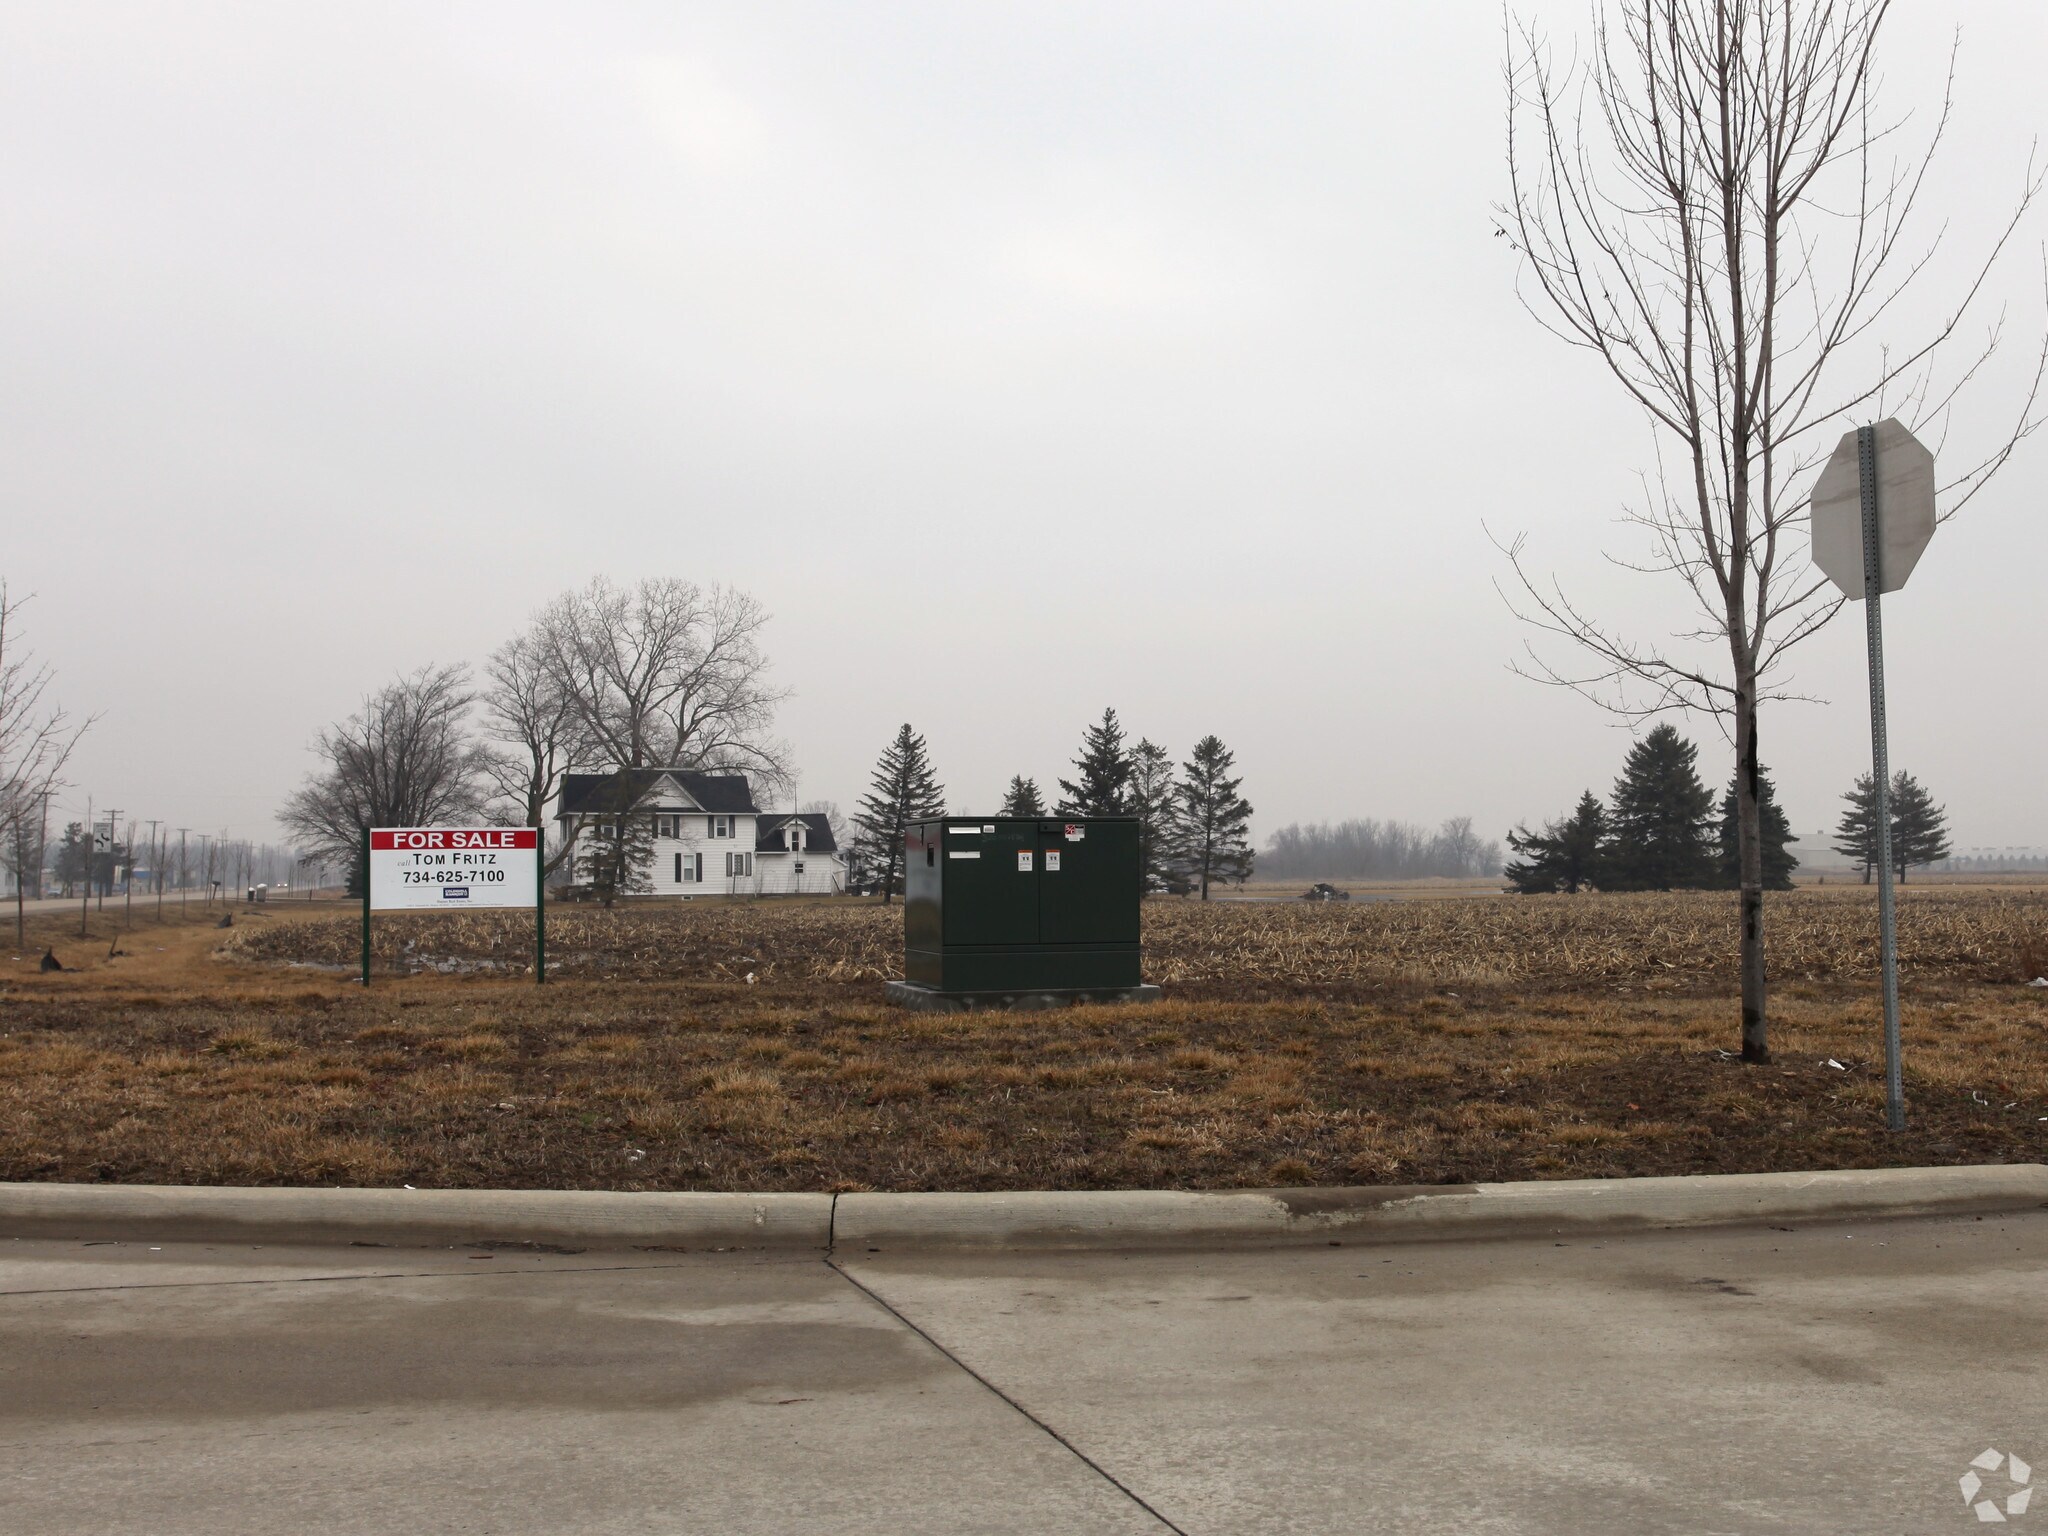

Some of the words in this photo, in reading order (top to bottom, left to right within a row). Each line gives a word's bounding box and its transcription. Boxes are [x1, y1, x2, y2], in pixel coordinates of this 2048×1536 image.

[393, 833, 444, 848] FOR
[452, 832, 515, 848] SALE
[413, 853, 445, 865] TOM
[453, 853, 496, 865] FRITZ
[403, 870, 505, 883] 734-625-7100
